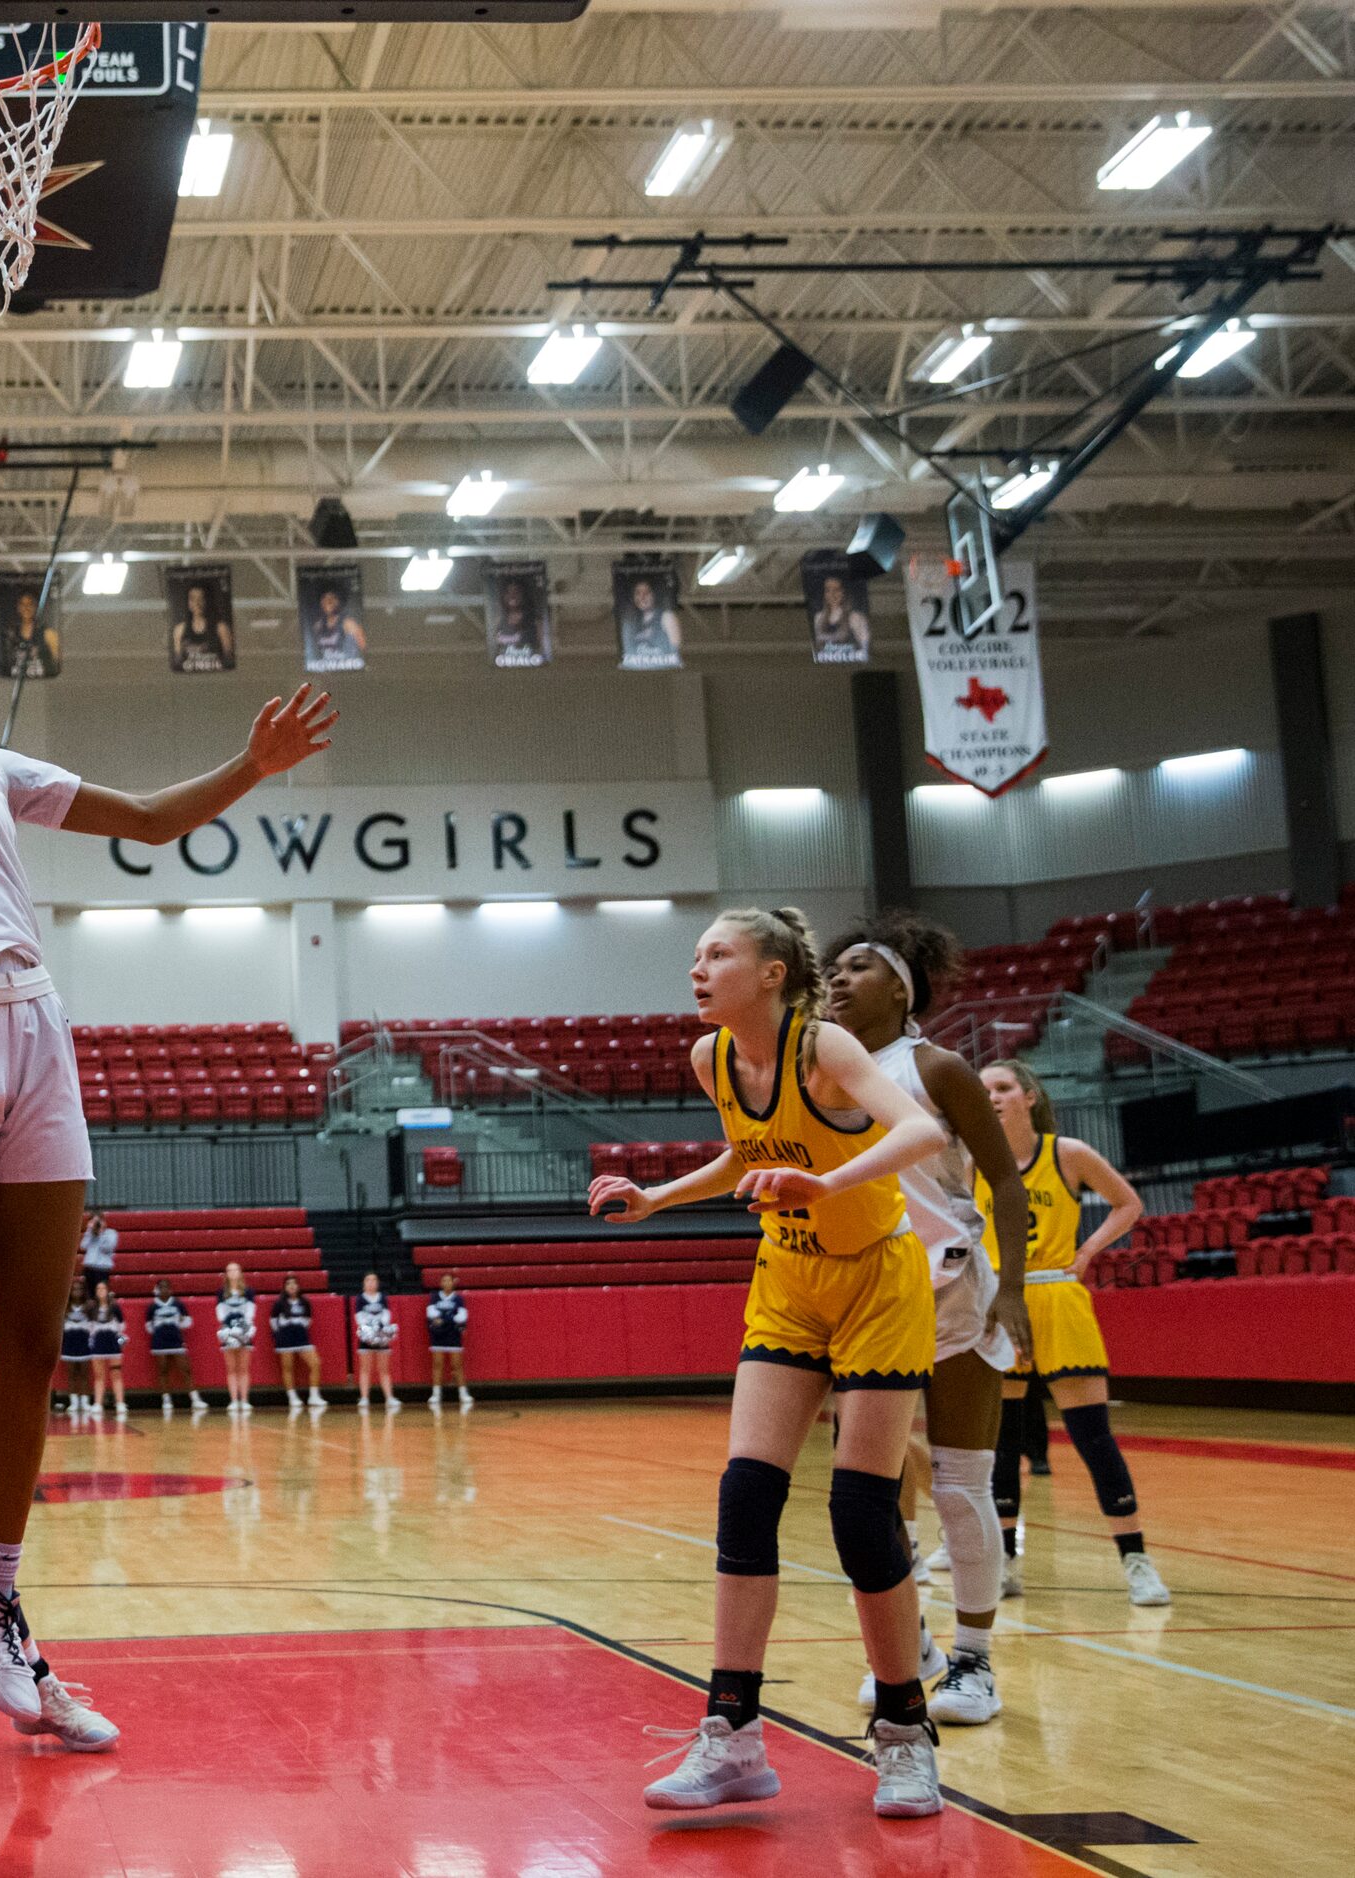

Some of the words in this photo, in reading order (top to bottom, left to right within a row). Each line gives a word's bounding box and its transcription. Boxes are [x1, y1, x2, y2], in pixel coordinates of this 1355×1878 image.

[938, 641, 1012, 656] COWGIRL
[927, 656, 1027, 672] VOLLEYBALL
[109, 809, 662, 876] COWGIRLS
[779, 1226, 827, 1254] PARK
